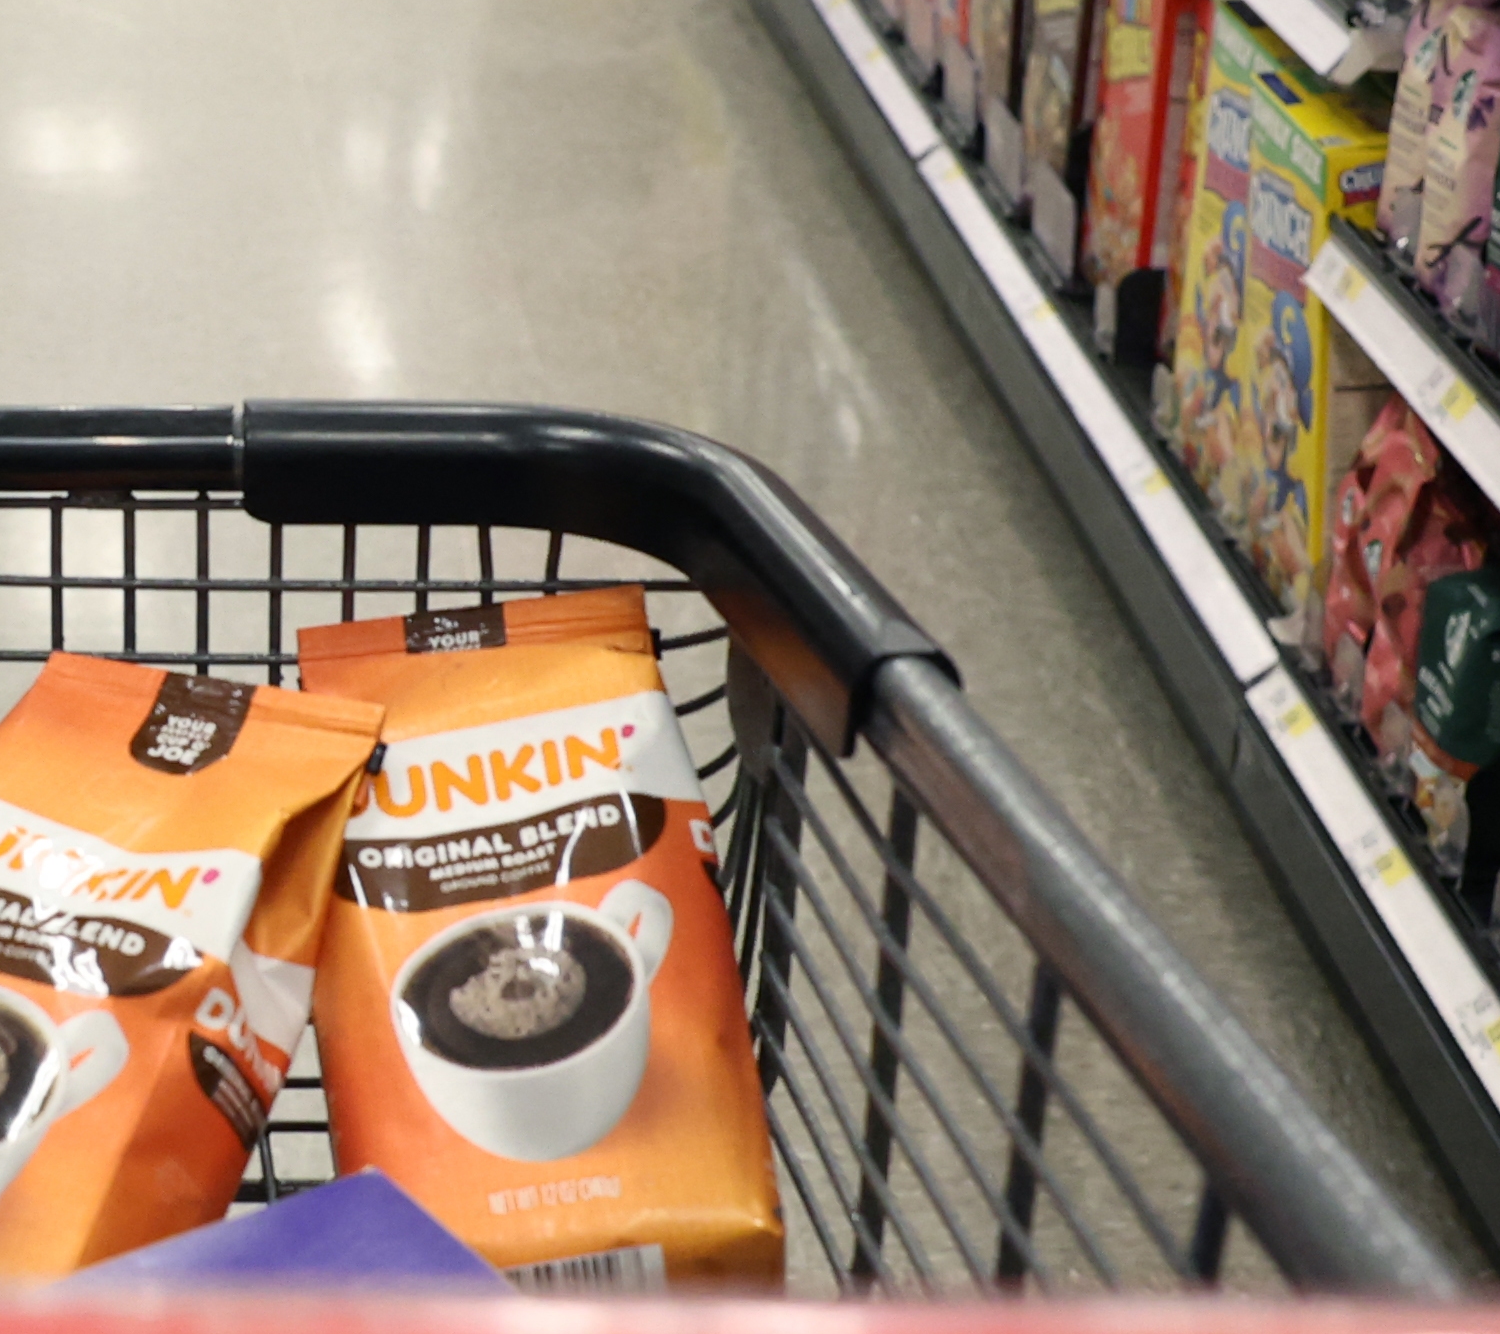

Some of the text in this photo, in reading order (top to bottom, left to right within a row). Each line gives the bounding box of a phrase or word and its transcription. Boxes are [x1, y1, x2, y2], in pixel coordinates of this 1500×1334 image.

[428, 630, 481, 650] YOUR
[167, 714, 217, 737] YOUR
[147, 743, 199, 766] JOE
[357, 804, 622, 870] ORIGINAL BLEND
[429, 842, 557, 881] MEDIUM ROAST
[439, 861, 552, 894] GROUND COFFEE
